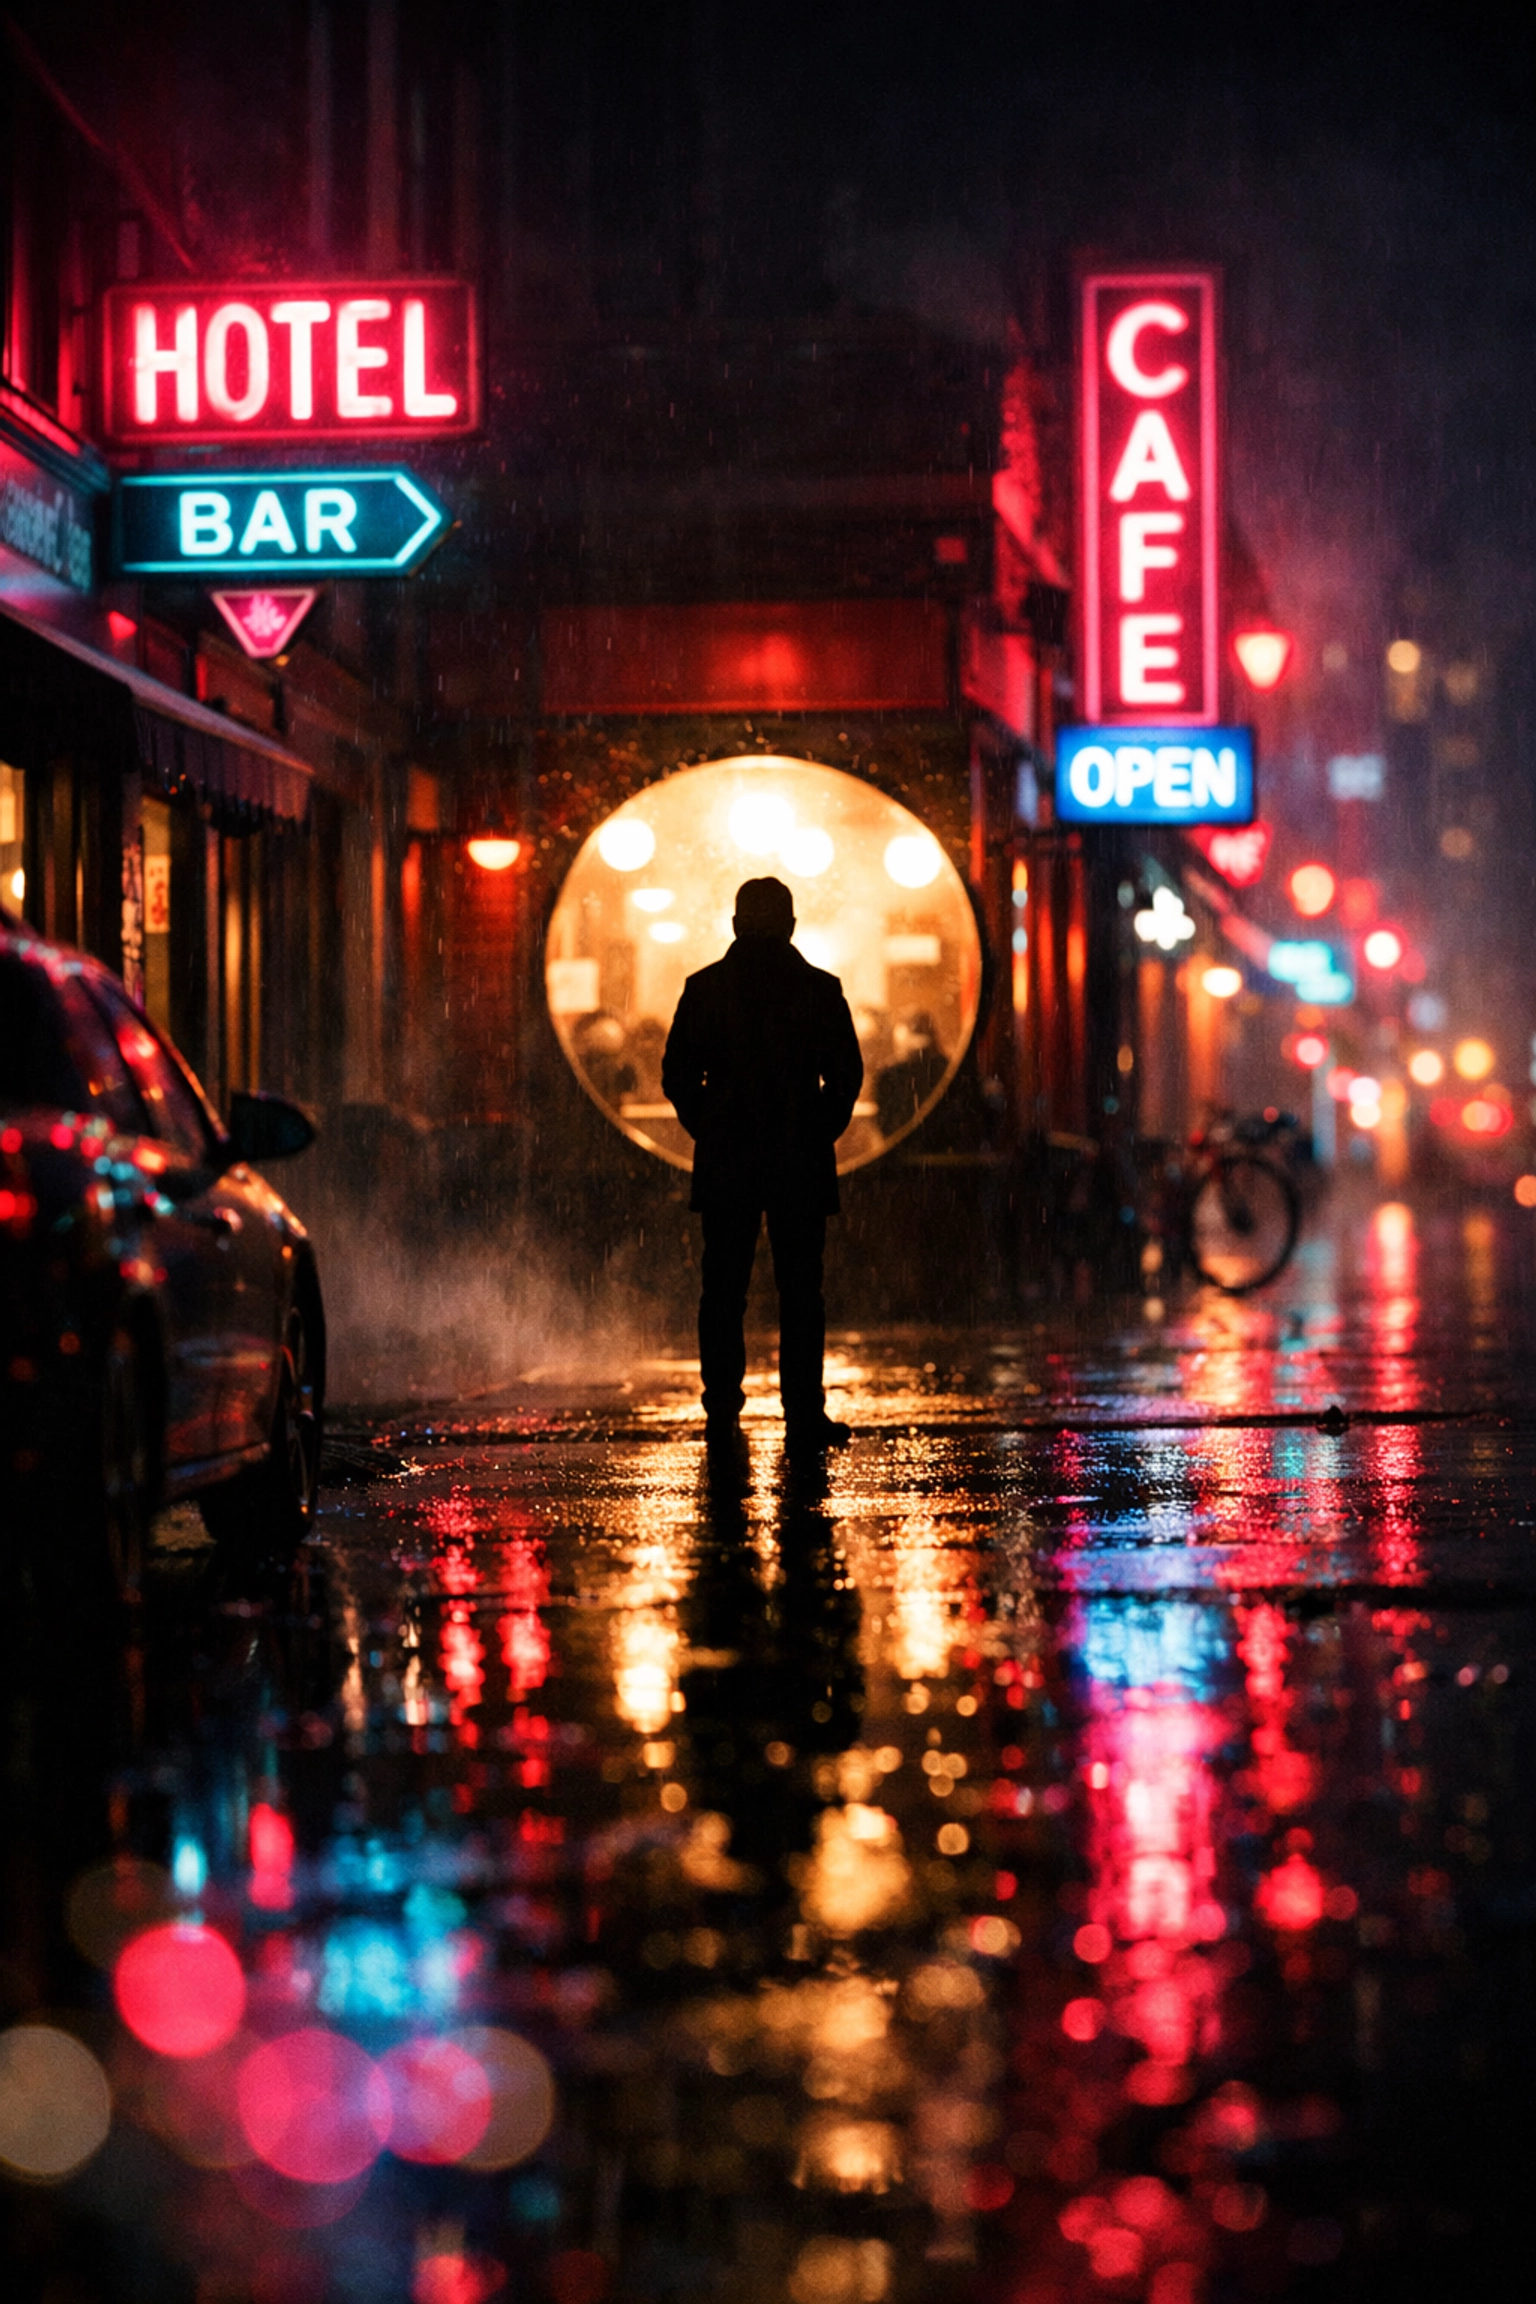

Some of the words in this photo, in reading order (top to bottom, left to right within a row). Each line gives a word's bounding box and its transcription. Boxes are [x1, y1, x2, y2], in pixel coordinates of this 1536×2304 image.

[134, 299, 457, 423] HOTEL
[179, 489, 358, 556] BAR
[1107, 302, 1191, 704] CAFE
[1069, 746, 1236, 808] OPEN
